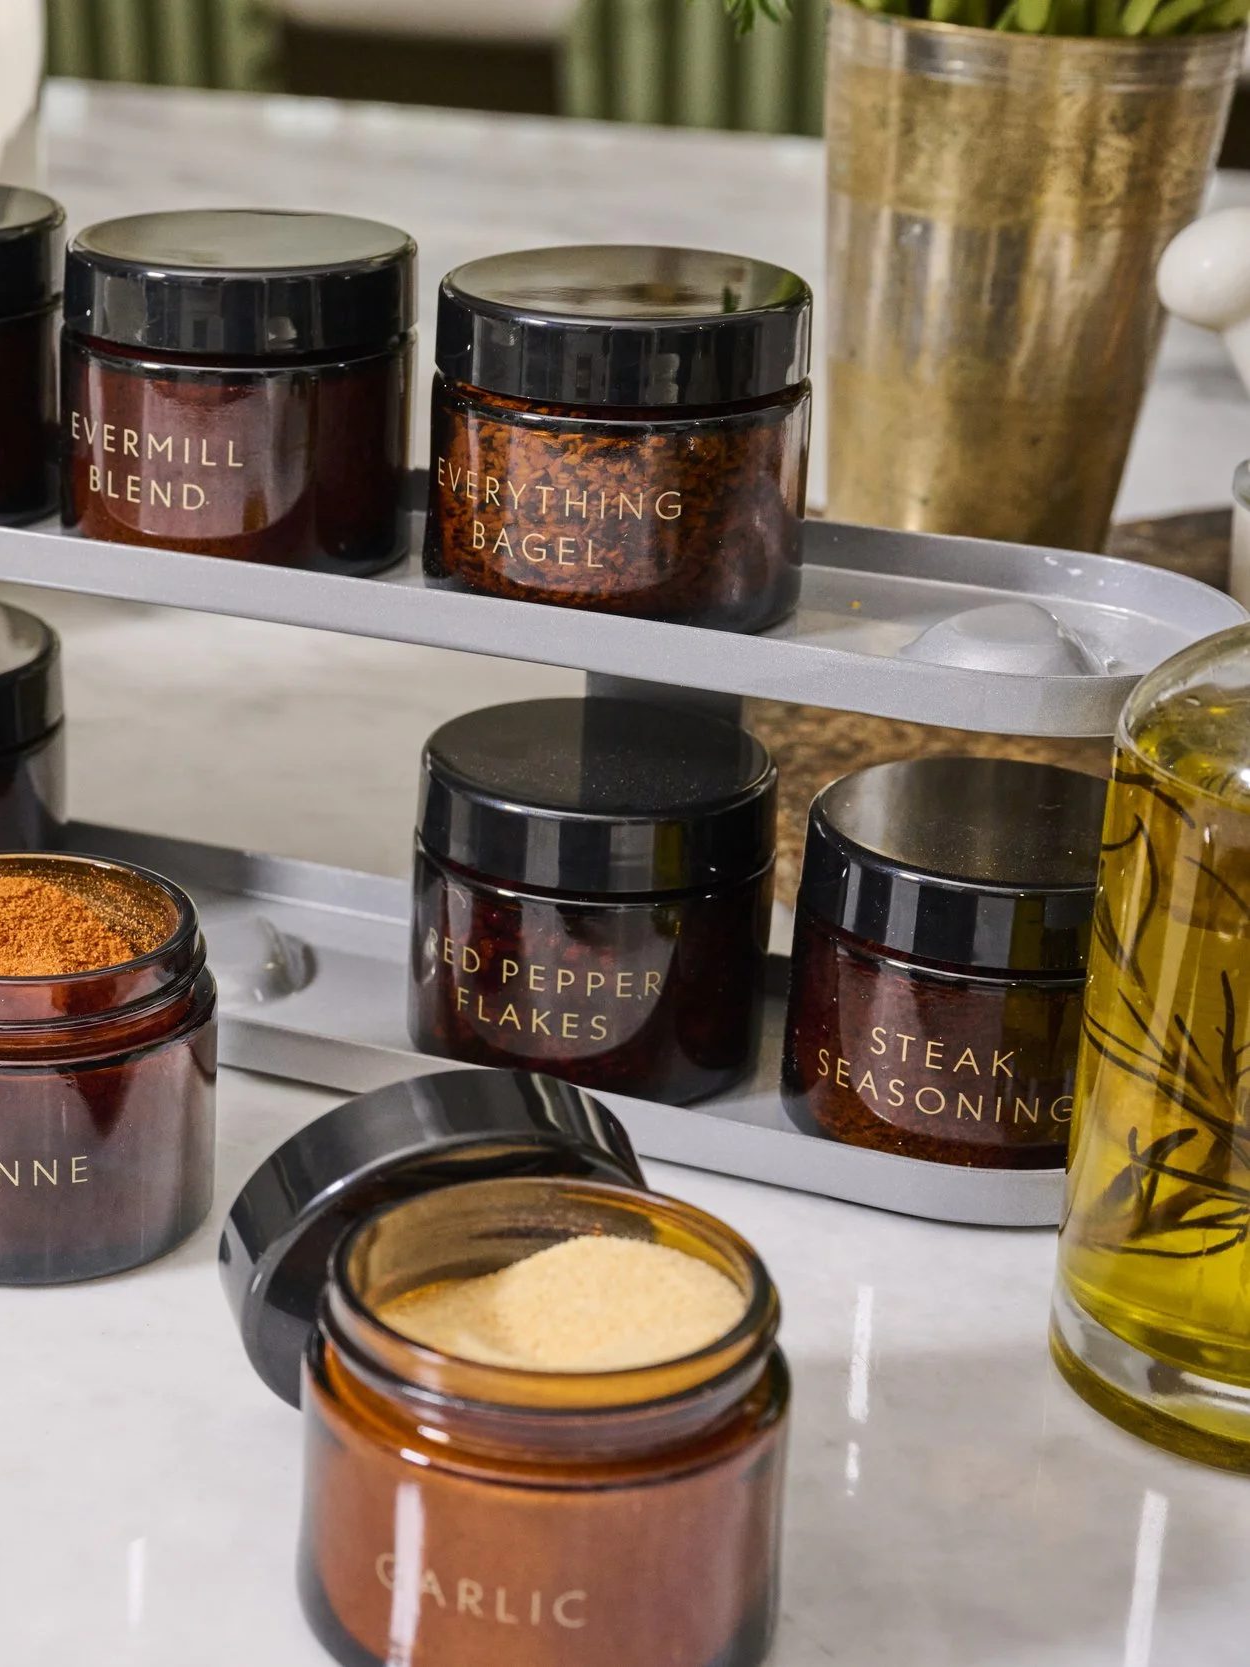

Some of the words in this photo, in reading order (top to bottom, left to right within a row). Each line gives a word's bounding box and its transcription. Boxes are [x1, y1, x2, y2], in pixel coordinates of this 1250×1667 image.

[71, 411, 244, 468] EVERMILL
[89, 463, 206, 511] BLEND
[437, 456, 683, 520] EVERYTHING
[473, 520, 604, 568] BAGEL
[429, 926, 481, 973] RED
[502, 959, 662, 998] PEPPER
[457, 987, 607, 1041] FLAKES
[870, 1027, 1014, 1078] STEAK
[817, 1048, 1074, 1123] SEASONING
